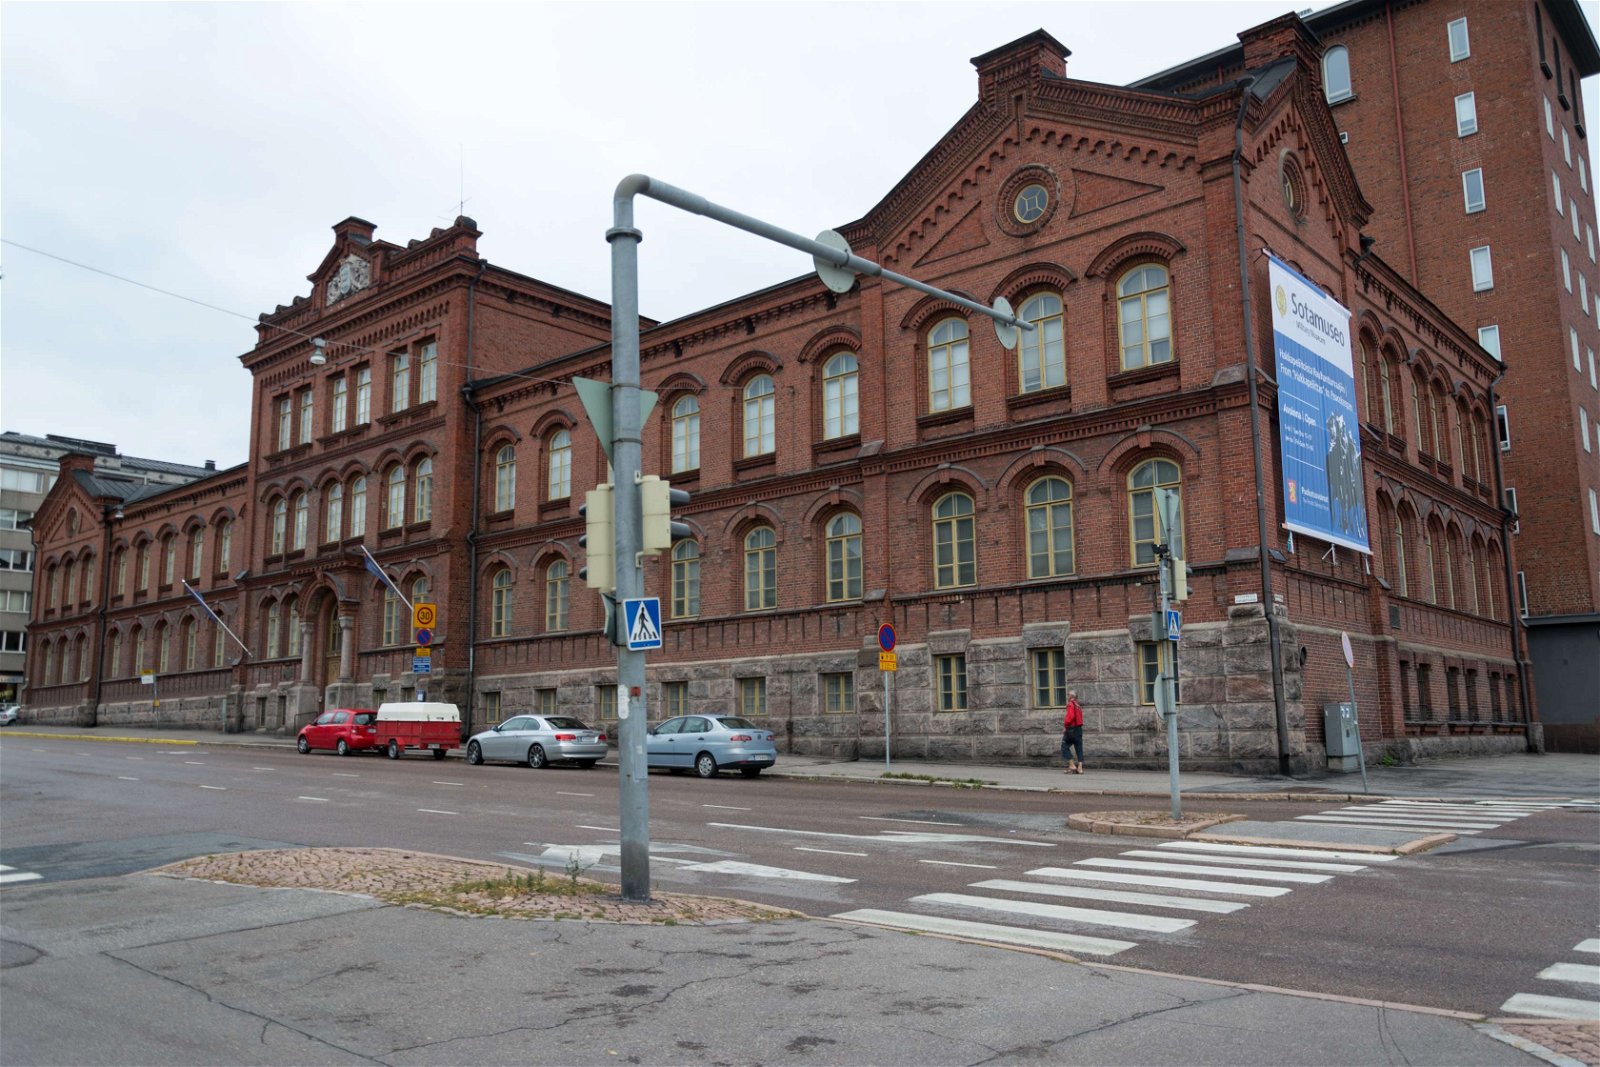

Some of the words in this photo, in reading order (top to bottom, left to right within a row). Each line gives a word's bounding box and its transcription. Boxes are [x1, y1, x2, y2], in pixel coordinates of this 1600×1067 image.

[1291, 293, 1345, 347] Sotamuseo
[1310, 330, 1326, 345] Museum
[1280, 363, 1292, 378] From
[420, 611, 430, 621] 30
